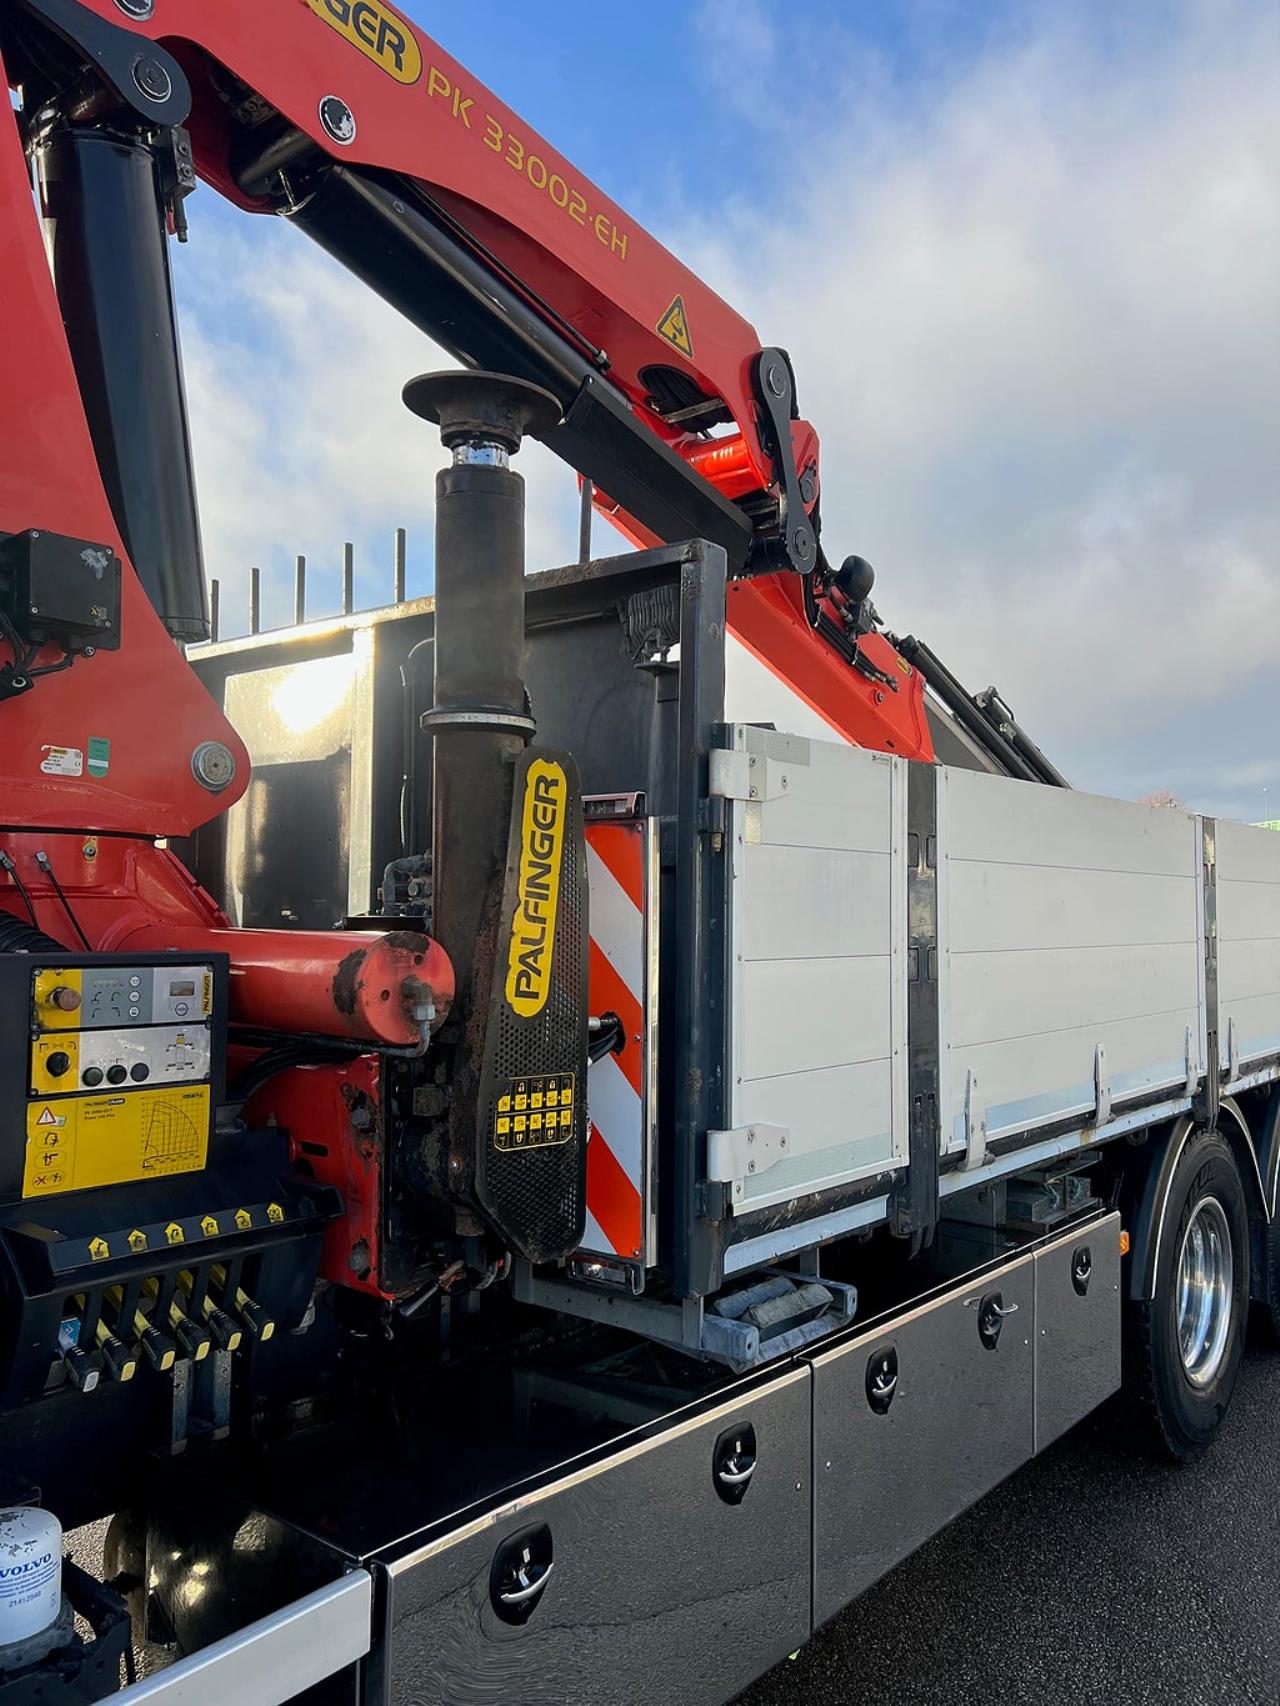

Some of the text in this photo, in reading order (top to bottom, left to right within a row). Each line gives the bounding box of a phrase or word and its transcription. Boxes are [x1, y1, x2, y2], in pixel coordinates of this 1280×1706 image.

[323, 0, 406, 72] GER
[427, 66, 475, 129] PK
[514, 774, 560, 1001] PALFINGER
[0, 1552, 52, 1578] VOLVO
